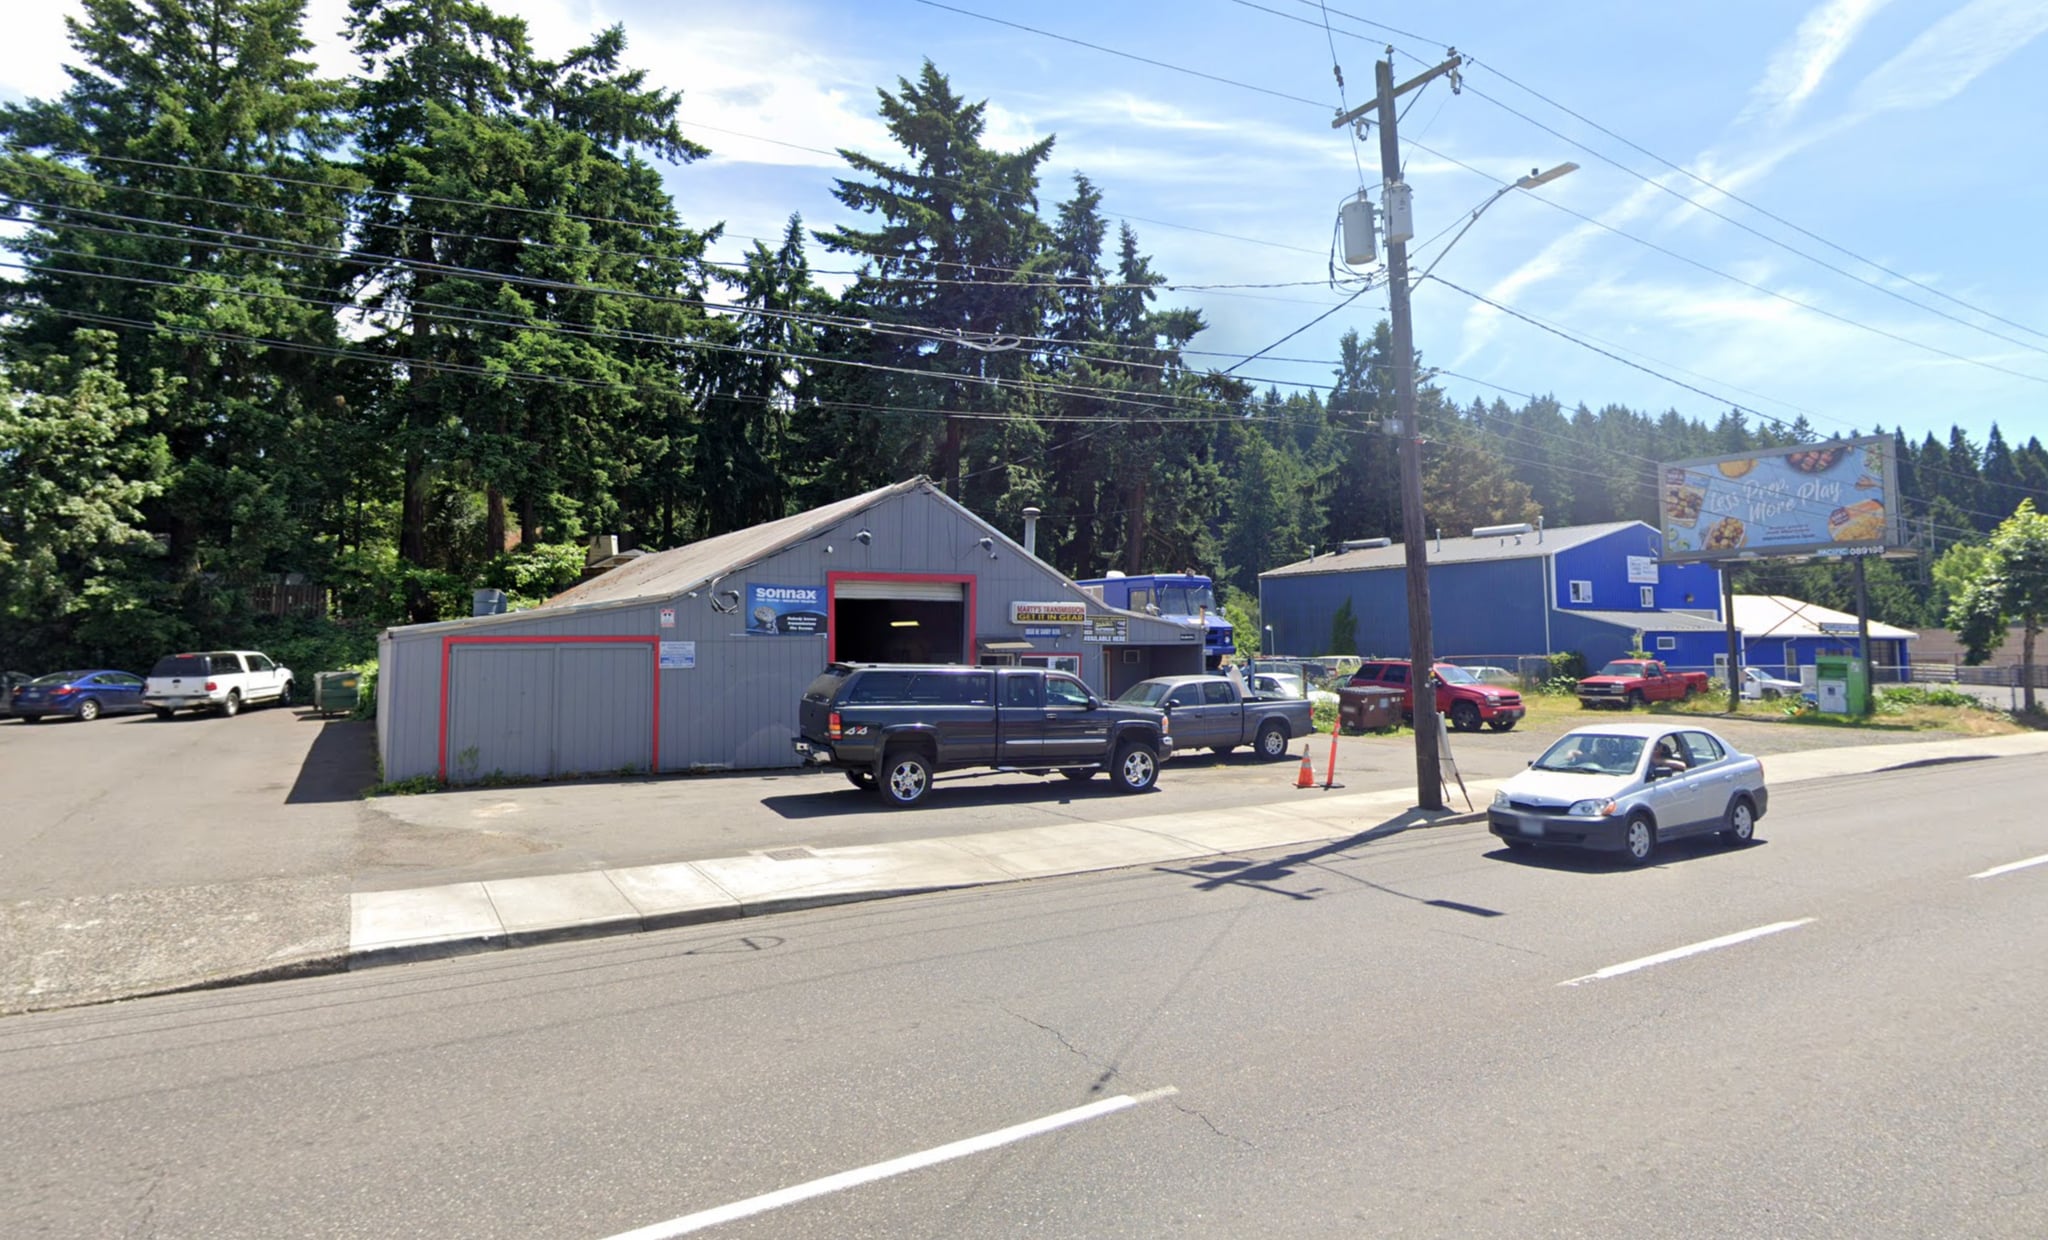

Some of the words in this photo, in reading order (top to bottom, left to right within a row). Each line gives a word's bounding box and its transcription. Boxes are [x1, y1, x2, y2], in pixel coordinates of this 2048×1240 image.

[1710, 491, 1740, 513] Less
[1749, 499, 1794, 522] More
[756, 587, 816, 600] sonnax
[1018, 613, 1036, 621] GET
[1038, 613, 1045, 621] IT
[1047, 613, 1057, 621] IN
[1058, 613, 1084, 621] GEAR
